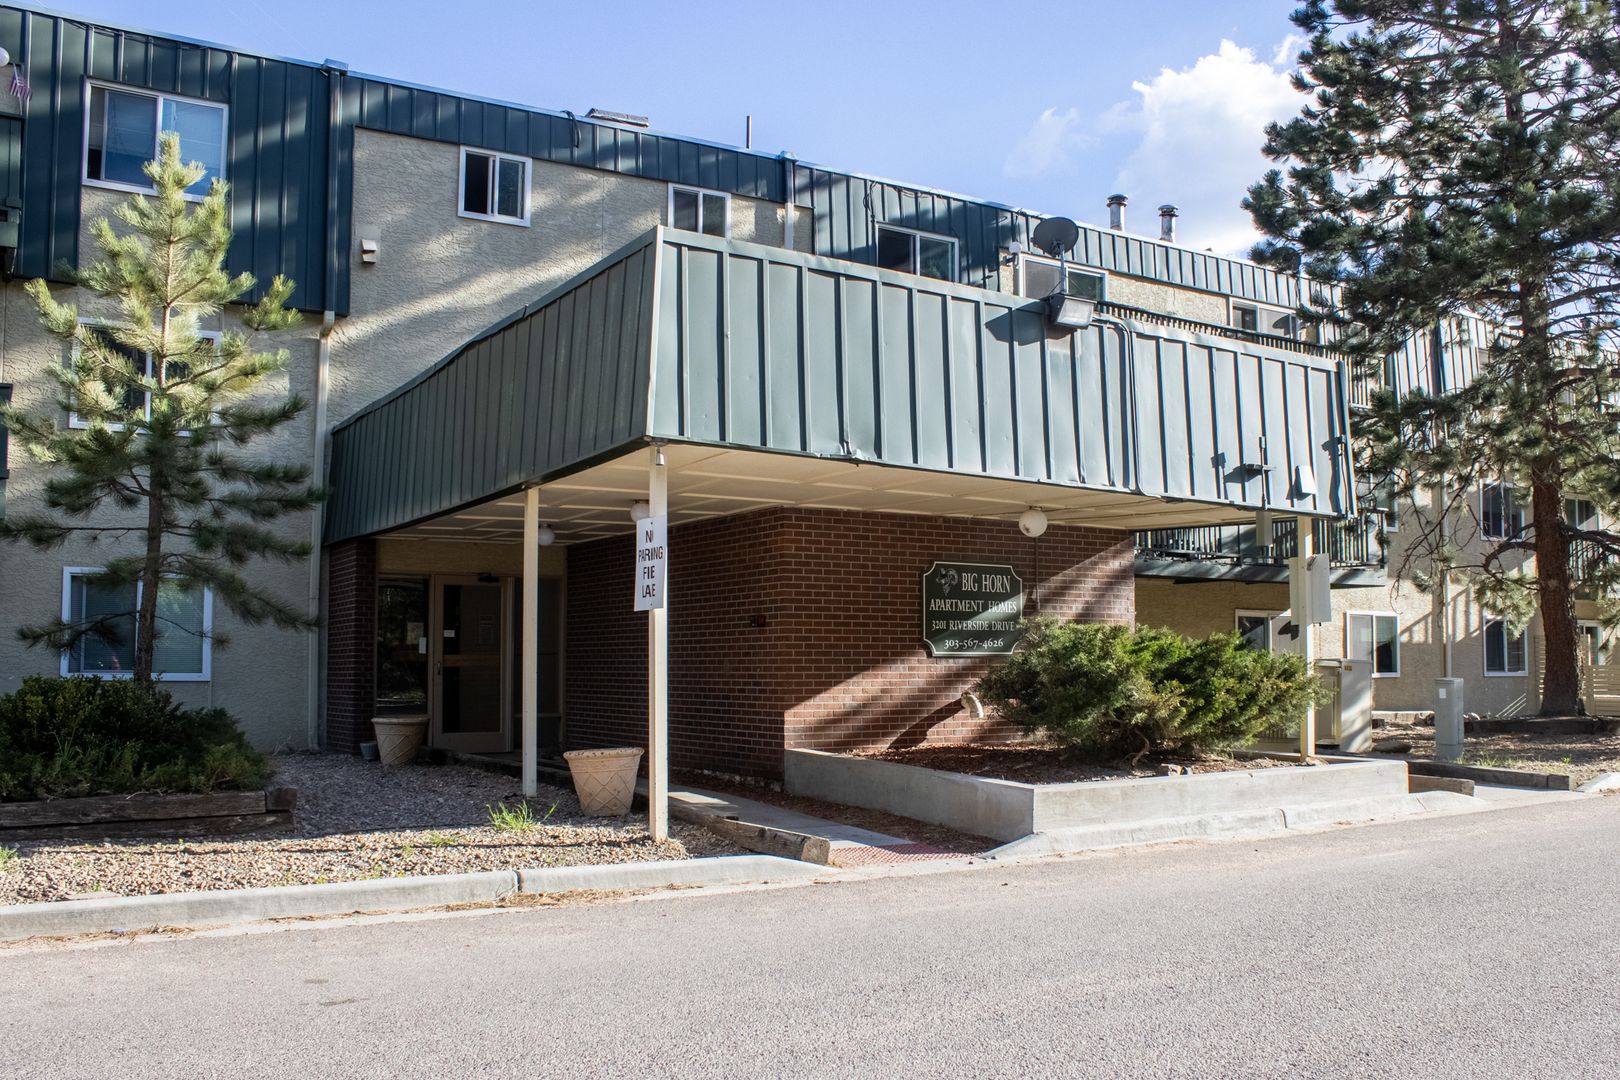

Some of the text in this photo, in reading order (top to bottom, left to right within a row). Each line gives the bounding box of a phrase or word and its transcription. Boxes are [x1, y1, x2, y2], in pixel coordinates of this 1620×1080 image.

[961, 572, 1011, 593] BIG HORN
[929, 598, 1017, 613] APARTMENT HOMES
[931, 620, 1015, 632] 3201 RIVERSIDE DRIVE
[943, 638, 1004, 649] 303-567-4626
